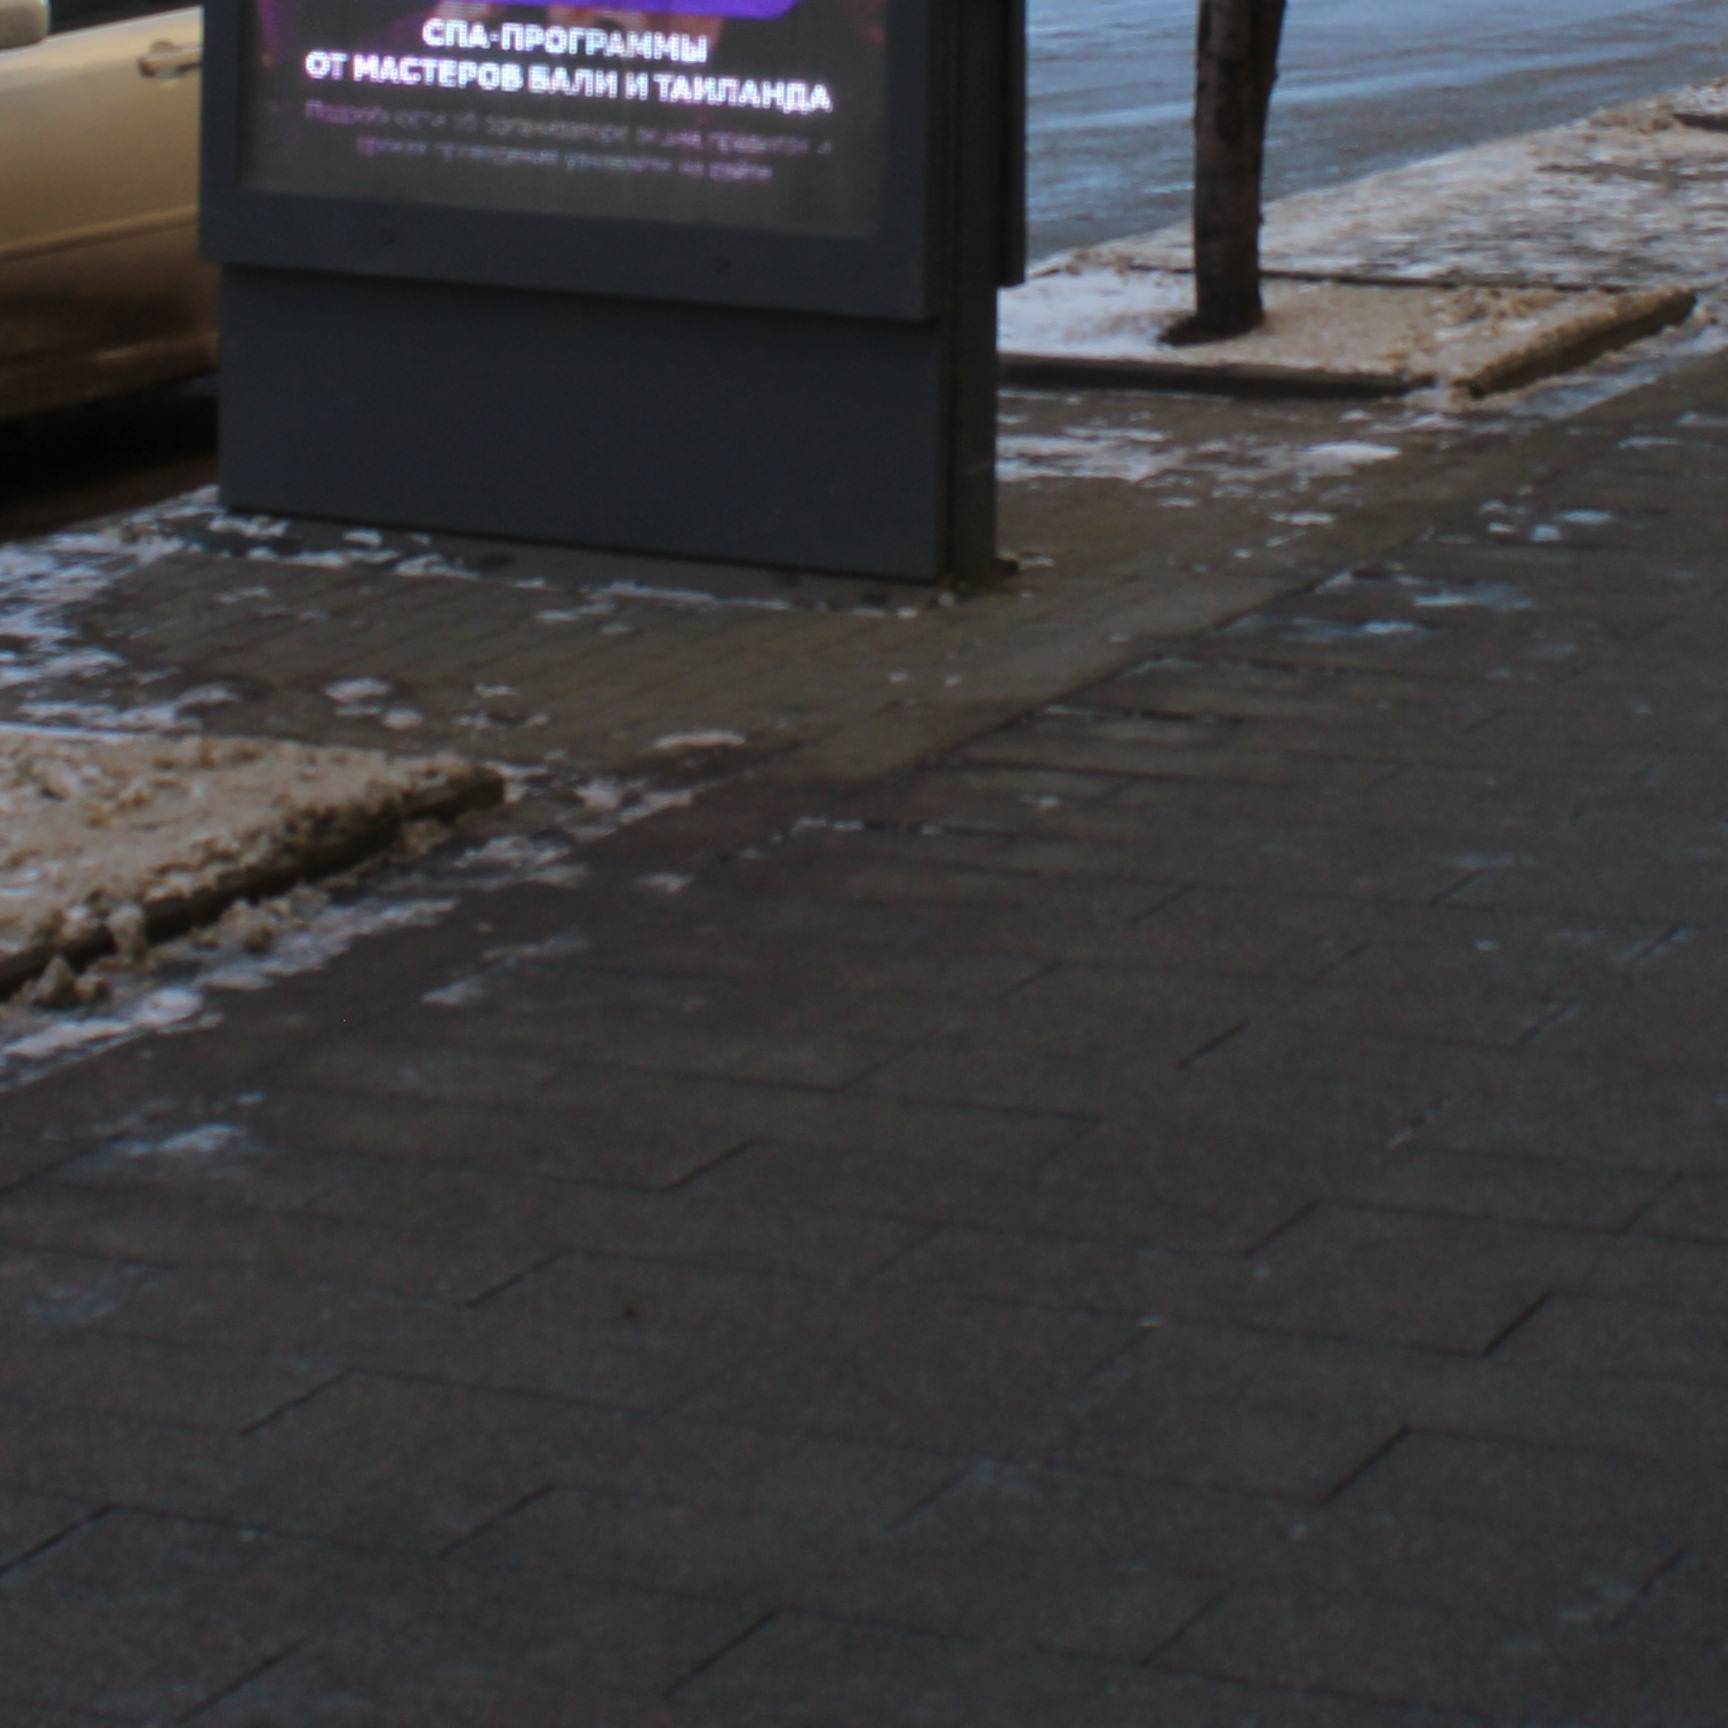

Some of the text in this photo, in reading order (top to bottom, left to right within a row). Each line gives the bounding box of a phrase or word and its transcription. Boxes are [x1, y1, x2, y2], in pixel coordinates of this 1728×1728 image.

[421, 18, 708, 63] СПА-ПРОГРАММЫ
[304, 50, 834, 115] ОТ МАСТЕРОВ БАЛИ И ТАИЛАНДА
